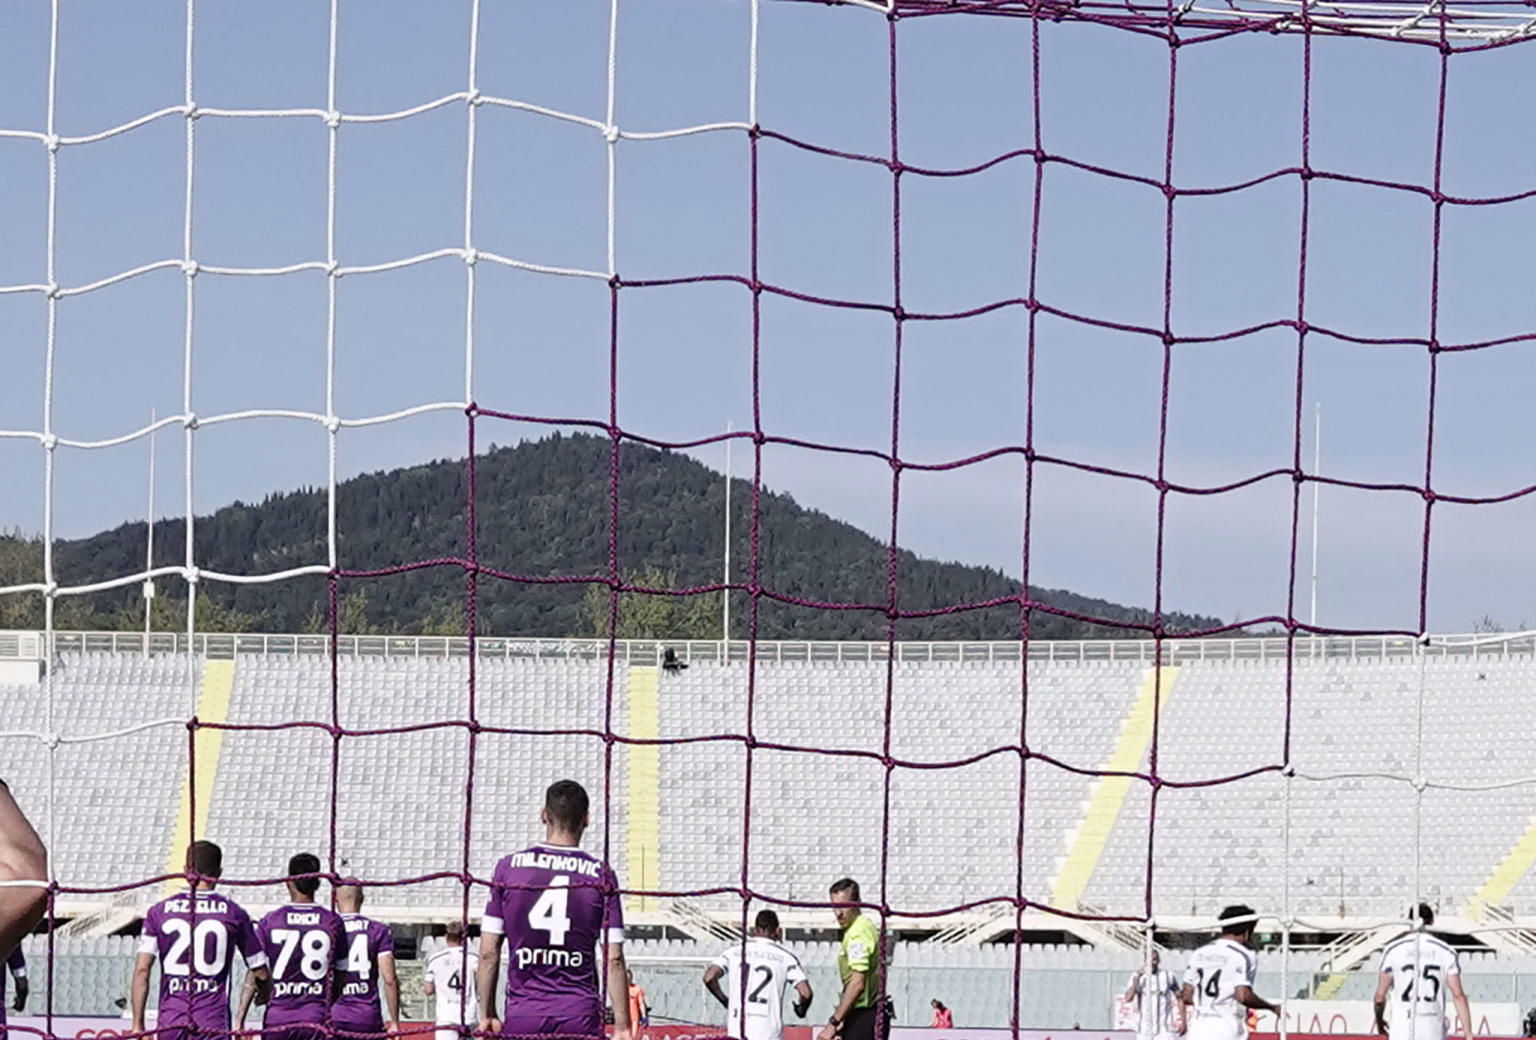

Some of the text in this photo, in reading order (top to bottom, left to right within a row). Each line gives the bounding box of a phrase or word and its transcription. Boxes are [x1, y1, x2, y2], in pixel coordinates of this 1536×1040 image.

[164, 899, 228, 914] PEZELLA
[528, 875, 571, 945] 4
[161, 917, 228, 976] 20
[270, 929, 332, 981] 78
[348, 933, 372, 980] 4
[515, 947, 583, 970] prima
[273, 982, 323, 998] prima
[1196, 967, 1223, 1004] 14
[1400, 963, 1441, 1003] 25
